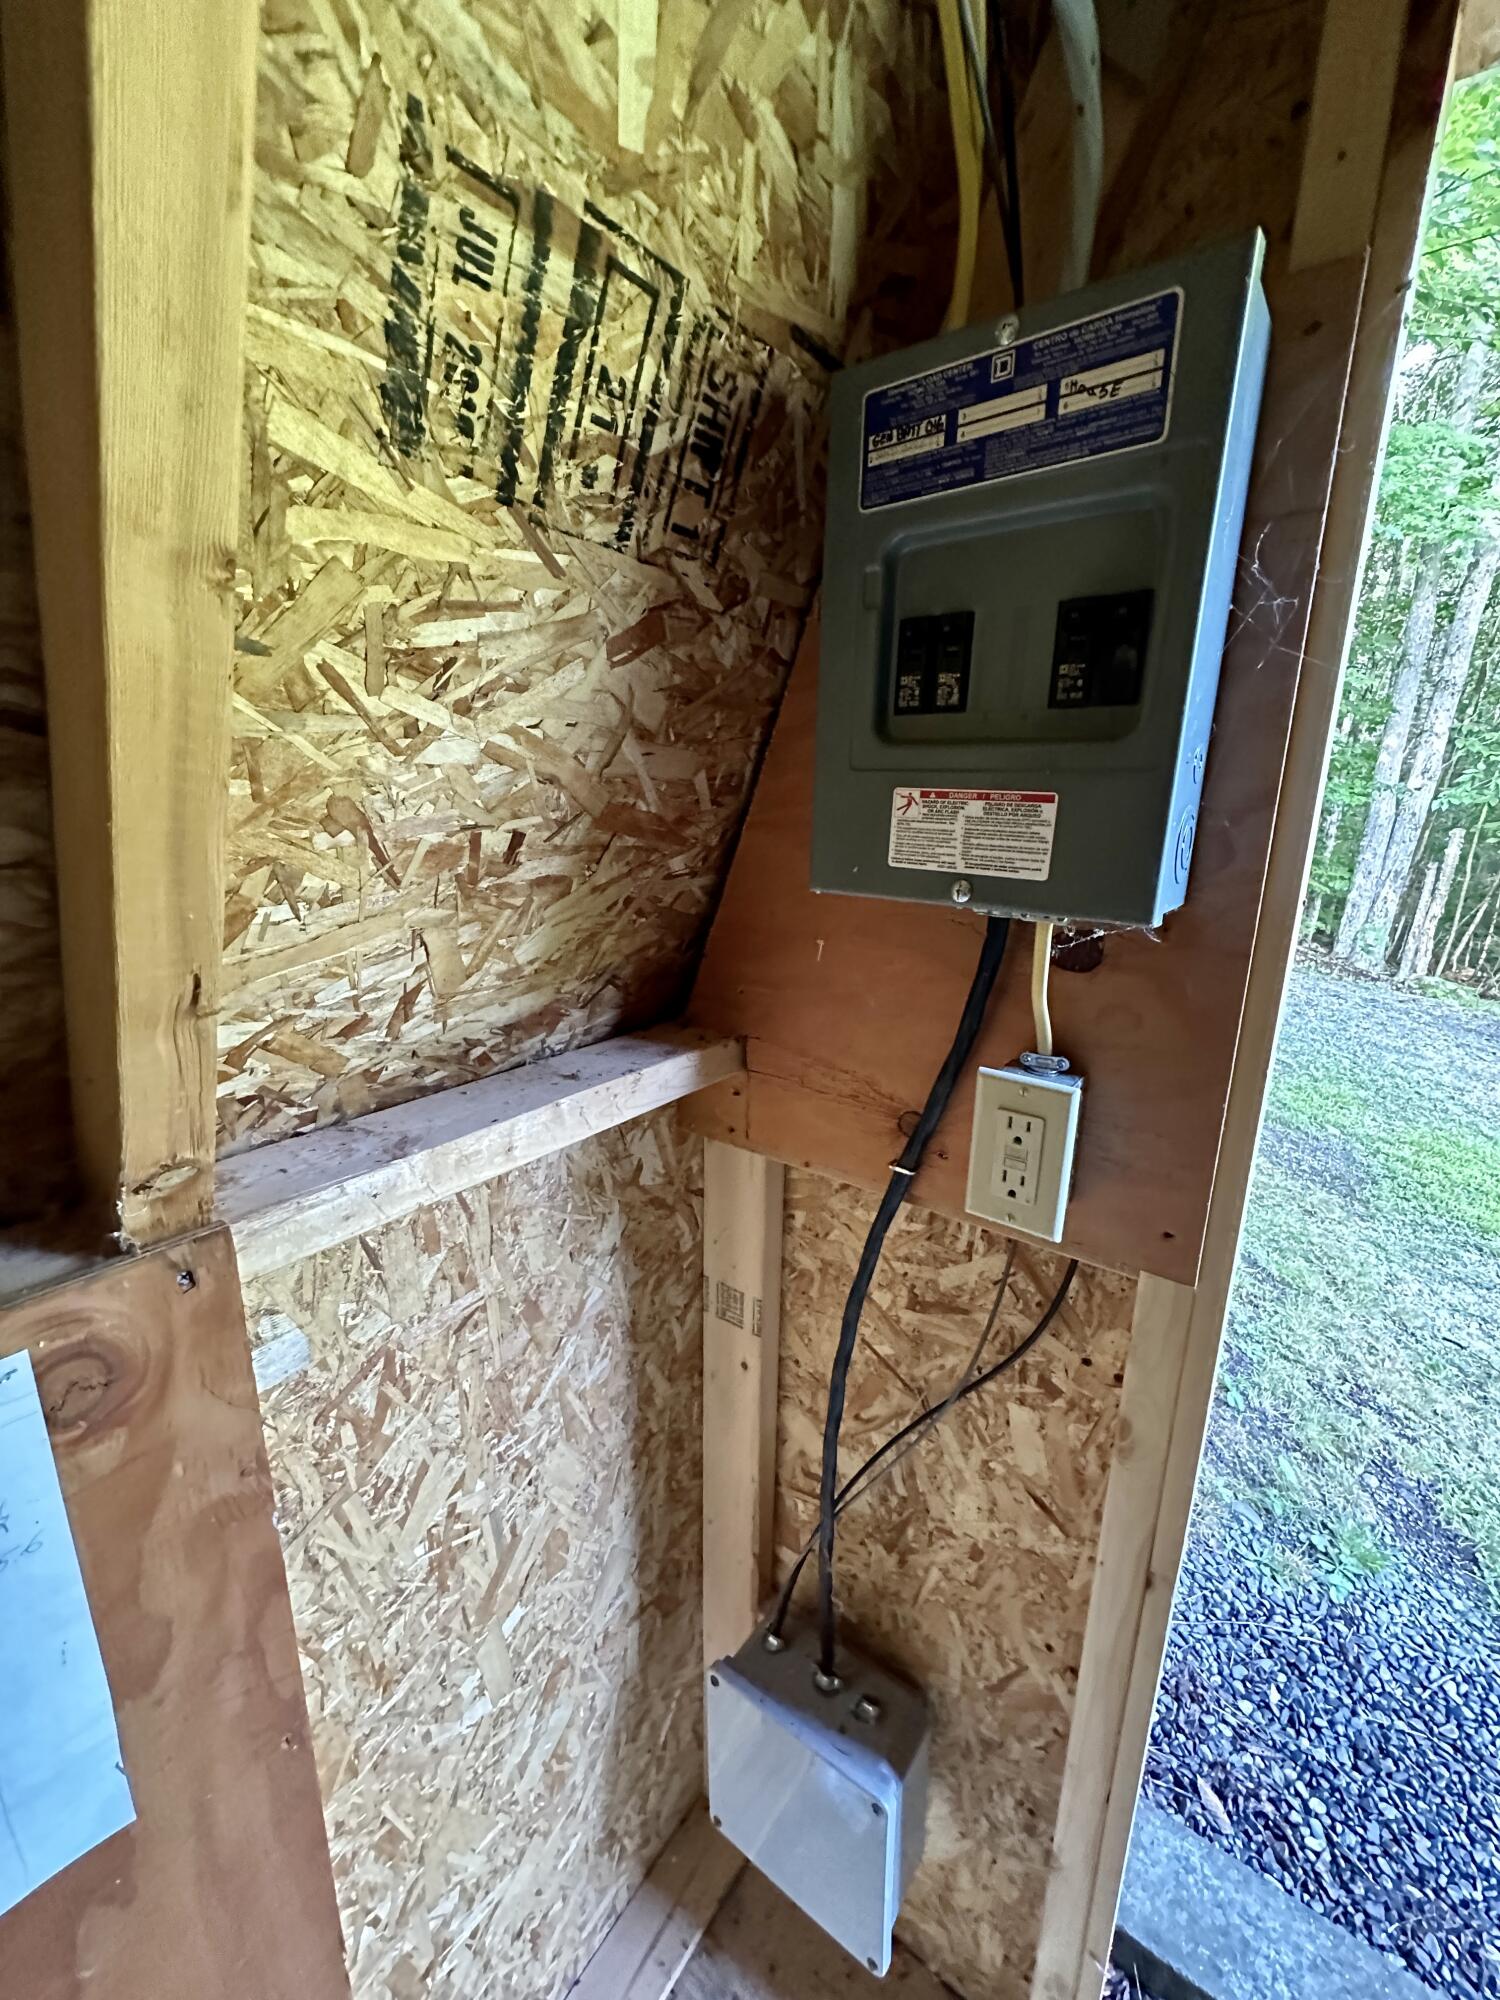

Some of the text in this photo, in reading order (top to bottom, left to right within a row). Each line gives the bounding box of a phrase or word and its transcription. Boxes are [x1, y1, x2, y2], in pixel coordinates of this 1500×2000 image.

[451, 206, 498, 292] JUL
[948, 791, 978, 800] DANGER
[989, 793, 1022, 801] PELIGRO
